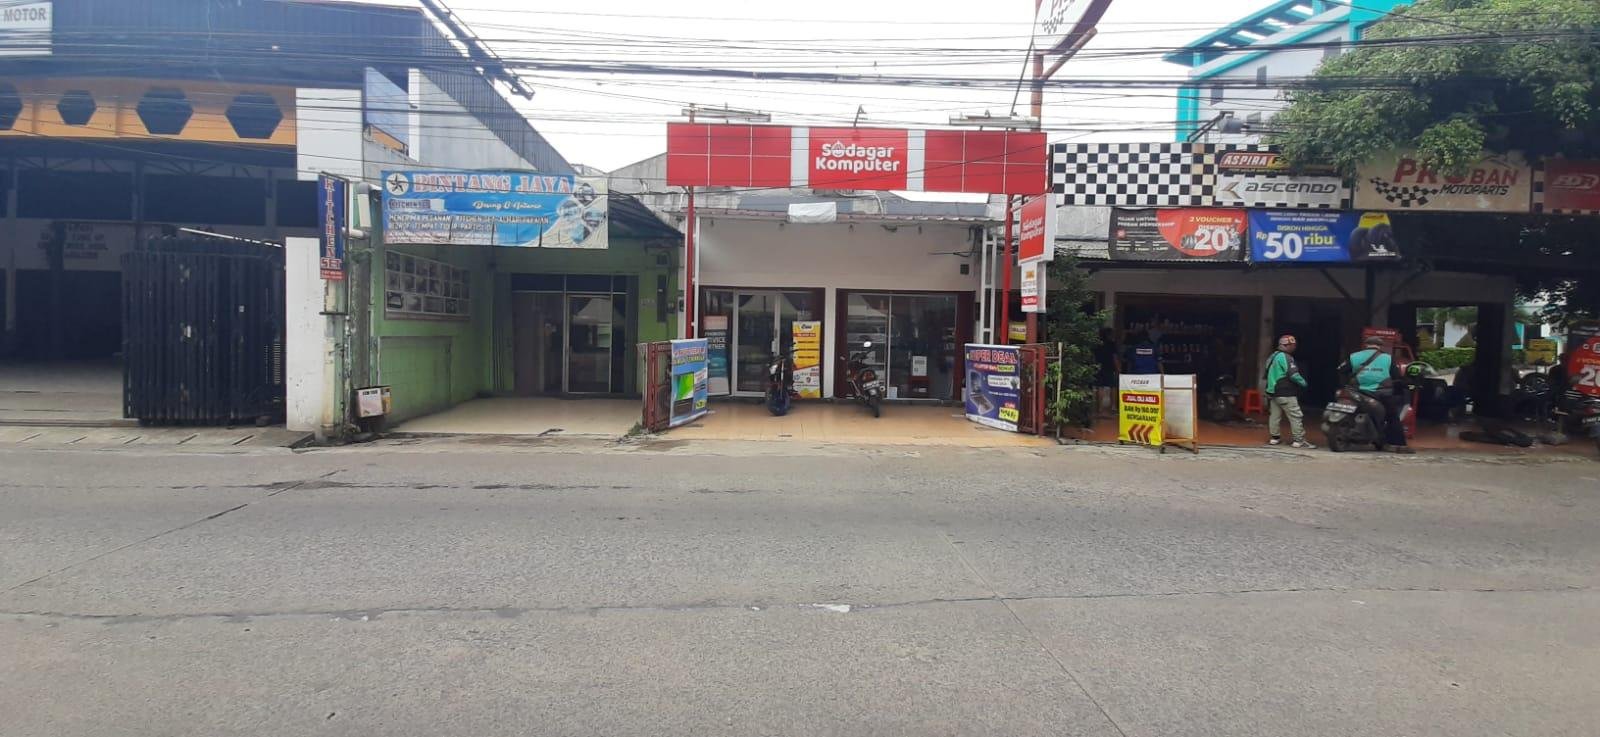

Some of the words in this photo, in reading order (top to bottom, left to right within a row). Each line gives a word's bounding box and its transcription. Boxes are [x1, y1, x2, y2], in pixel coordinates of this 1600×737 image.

[4, 8, 47, 21] MOTOR
[822, 141, 895, 161] Sodagar
[815, 157, 900, 174] Komputer
[1223, 155, 1268, 166] ASPIRA
[1394, 158, 1519, 185] PRBAN
[413, 173, 511, 193] BINTANG
[515, 174, 573, 194] JAYA
[1439, 184, 1509, 195] MOTOPARTS
[324, 178, 336, 258] KITCHEN
[1256, 232, 1268, 240] Rp
[1263, 232, 1303, 259] 50
[1304, 233, 1333, 245] ribu
[992, 350, 1018, 364] DEAL
